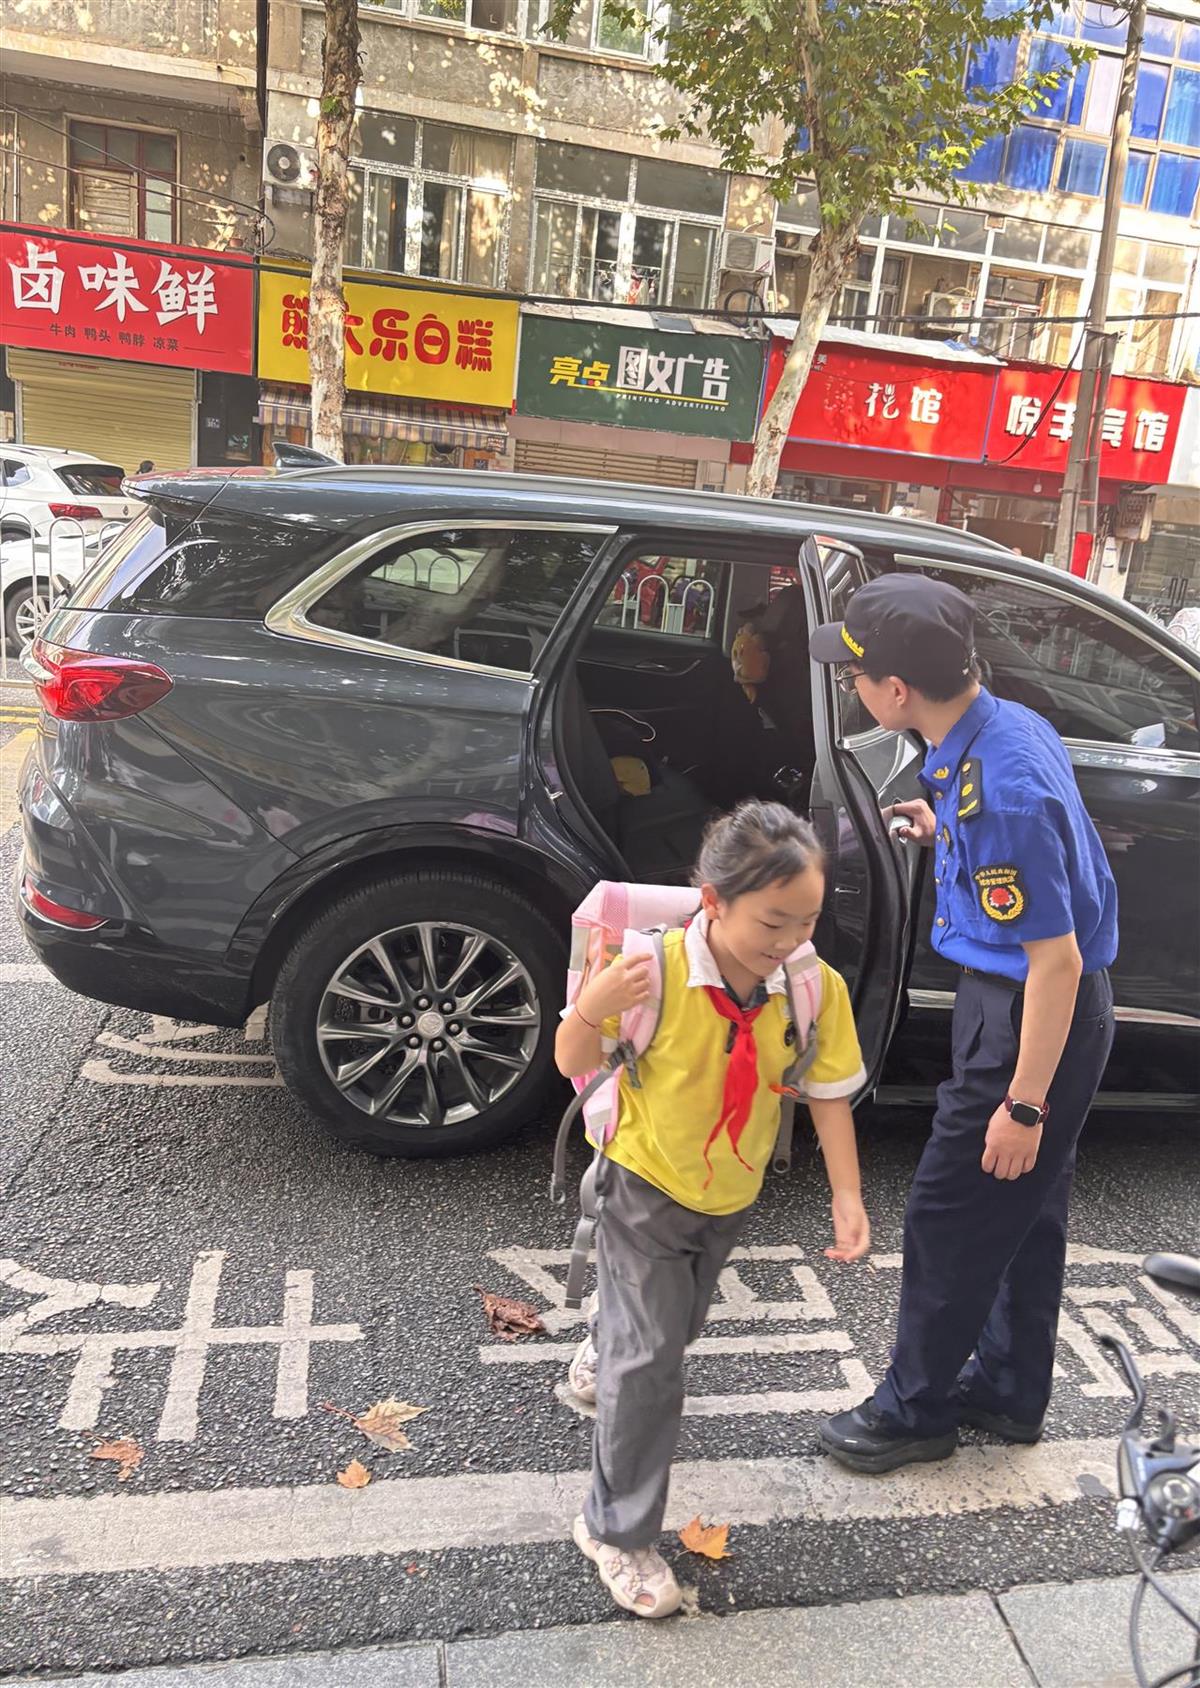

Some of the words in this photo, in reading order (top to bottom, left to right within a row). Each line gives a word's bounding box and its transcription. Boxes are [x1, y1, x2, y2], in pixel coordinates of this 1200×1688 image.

[8, 241, 218, 335] 卤味鲜
[50, 322, 77, 338] 牛肉
[84, 327, 111, 342] 鸭头
[153, 336, 179, 351] 凉菜
[550, 356, 611, 387] 亮点
[616, 345, 731, 401] 图文广告
[616, 393, 660, 404] PRINTING
[665, 399, 727, 412] ADVERTISING
